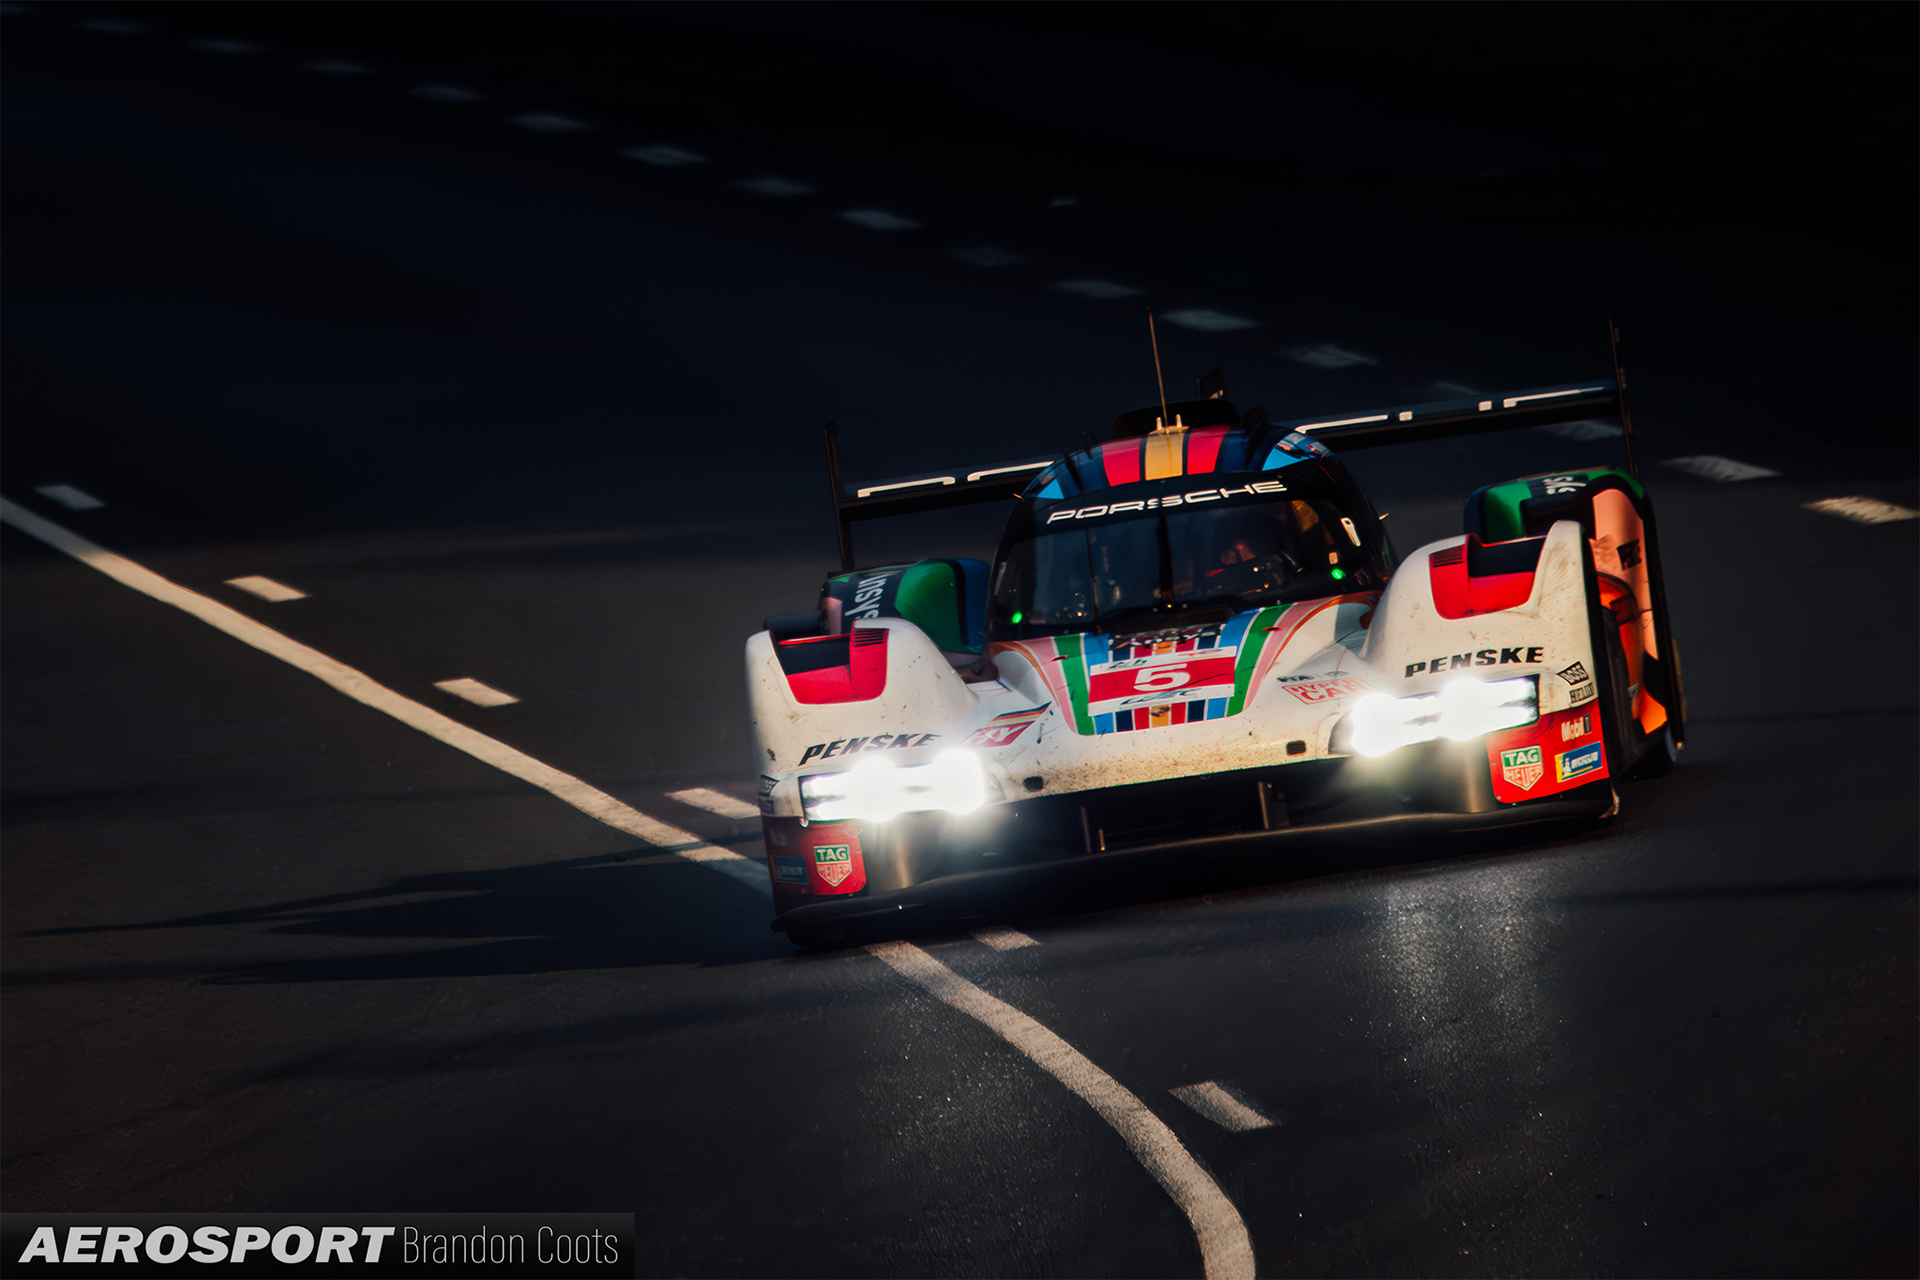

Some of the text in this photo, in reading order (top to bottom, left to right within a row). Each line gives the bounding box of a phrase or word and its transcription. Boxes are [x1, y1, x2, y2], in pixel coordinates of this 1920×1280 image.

[1046, 480, 1287, 525] PORSCHE
[1404, 646, 1545, 678] PENSKE
[1133, 663, 1191, 692] 5
[1561, 716, 1584, 742] Mobil
[798, 732, 942, 767] PENSKE
[1505, 749, 1539, 766] TAG
[816, 847, 846, 861] TAG
